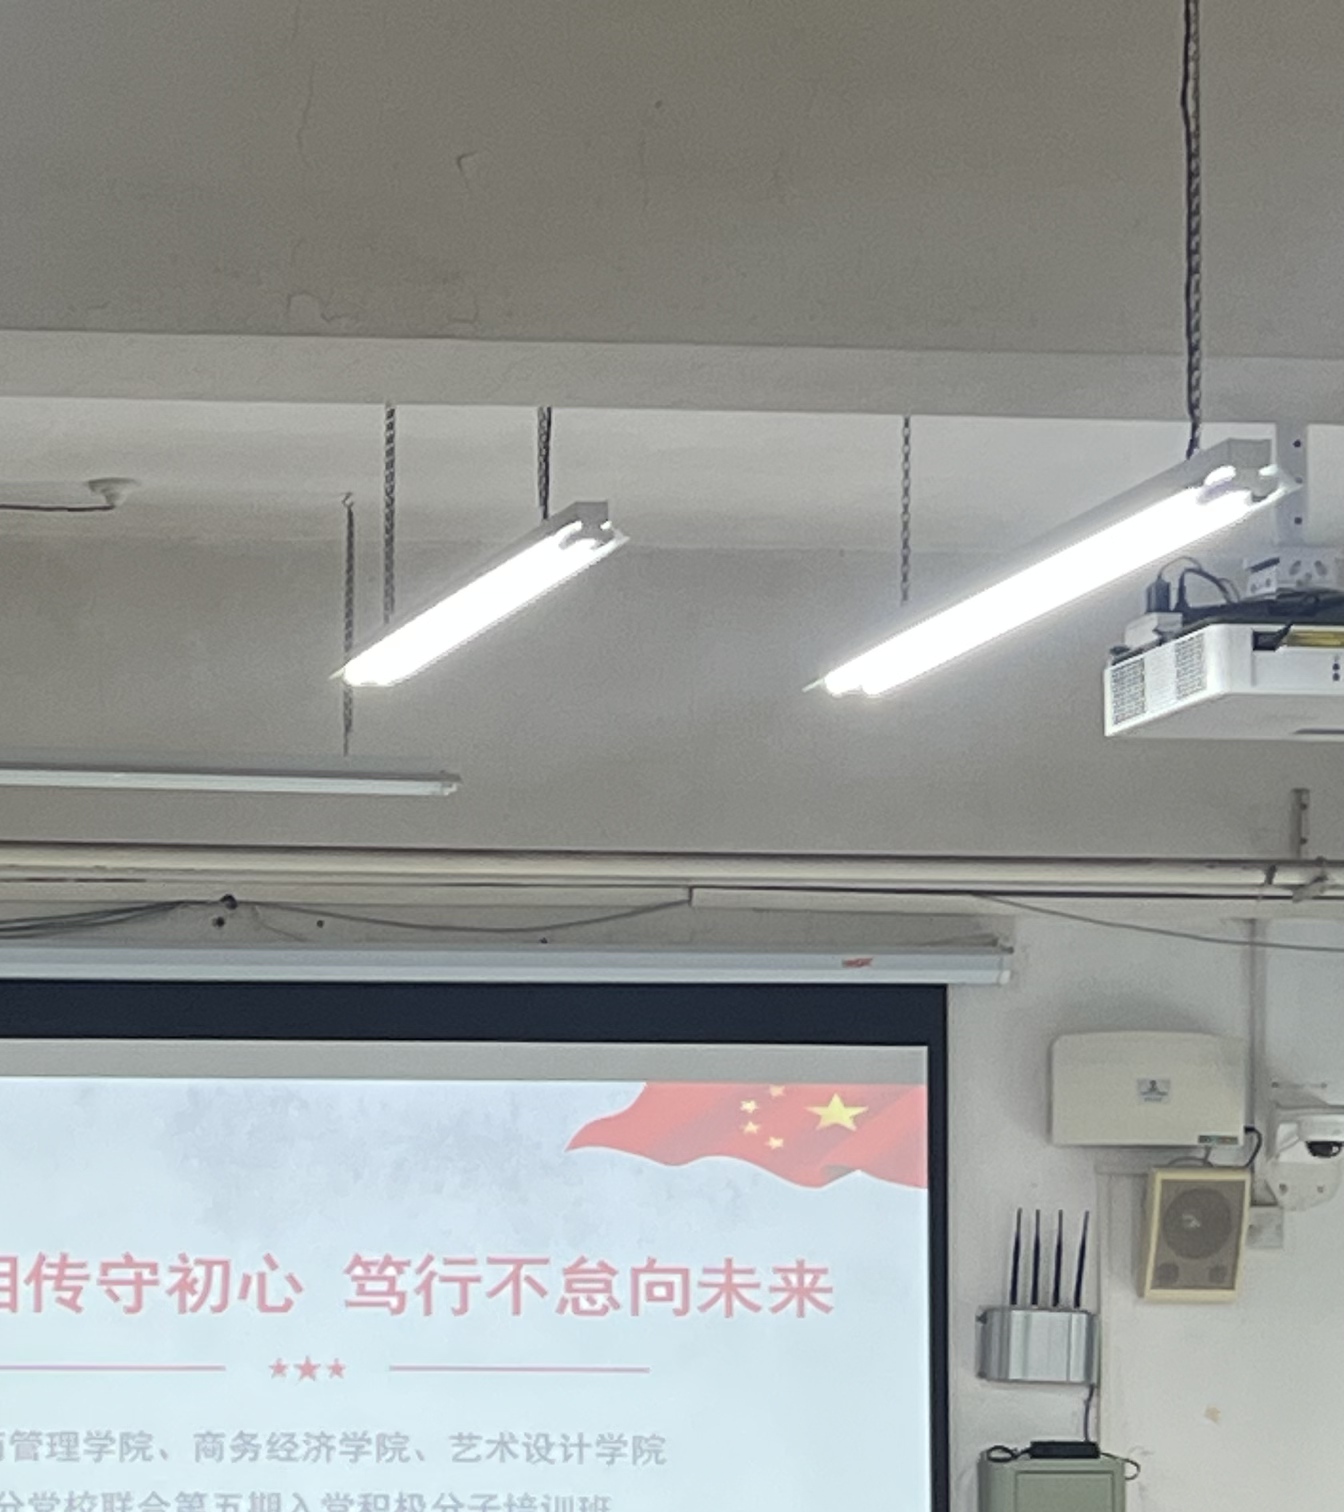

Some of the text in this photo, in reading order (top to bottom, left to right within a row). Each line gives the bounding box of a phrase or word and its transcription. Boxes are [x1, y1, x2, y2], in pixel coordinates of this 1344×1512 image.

[343, 1253, 835, 1319] 笃行不怠向未来
